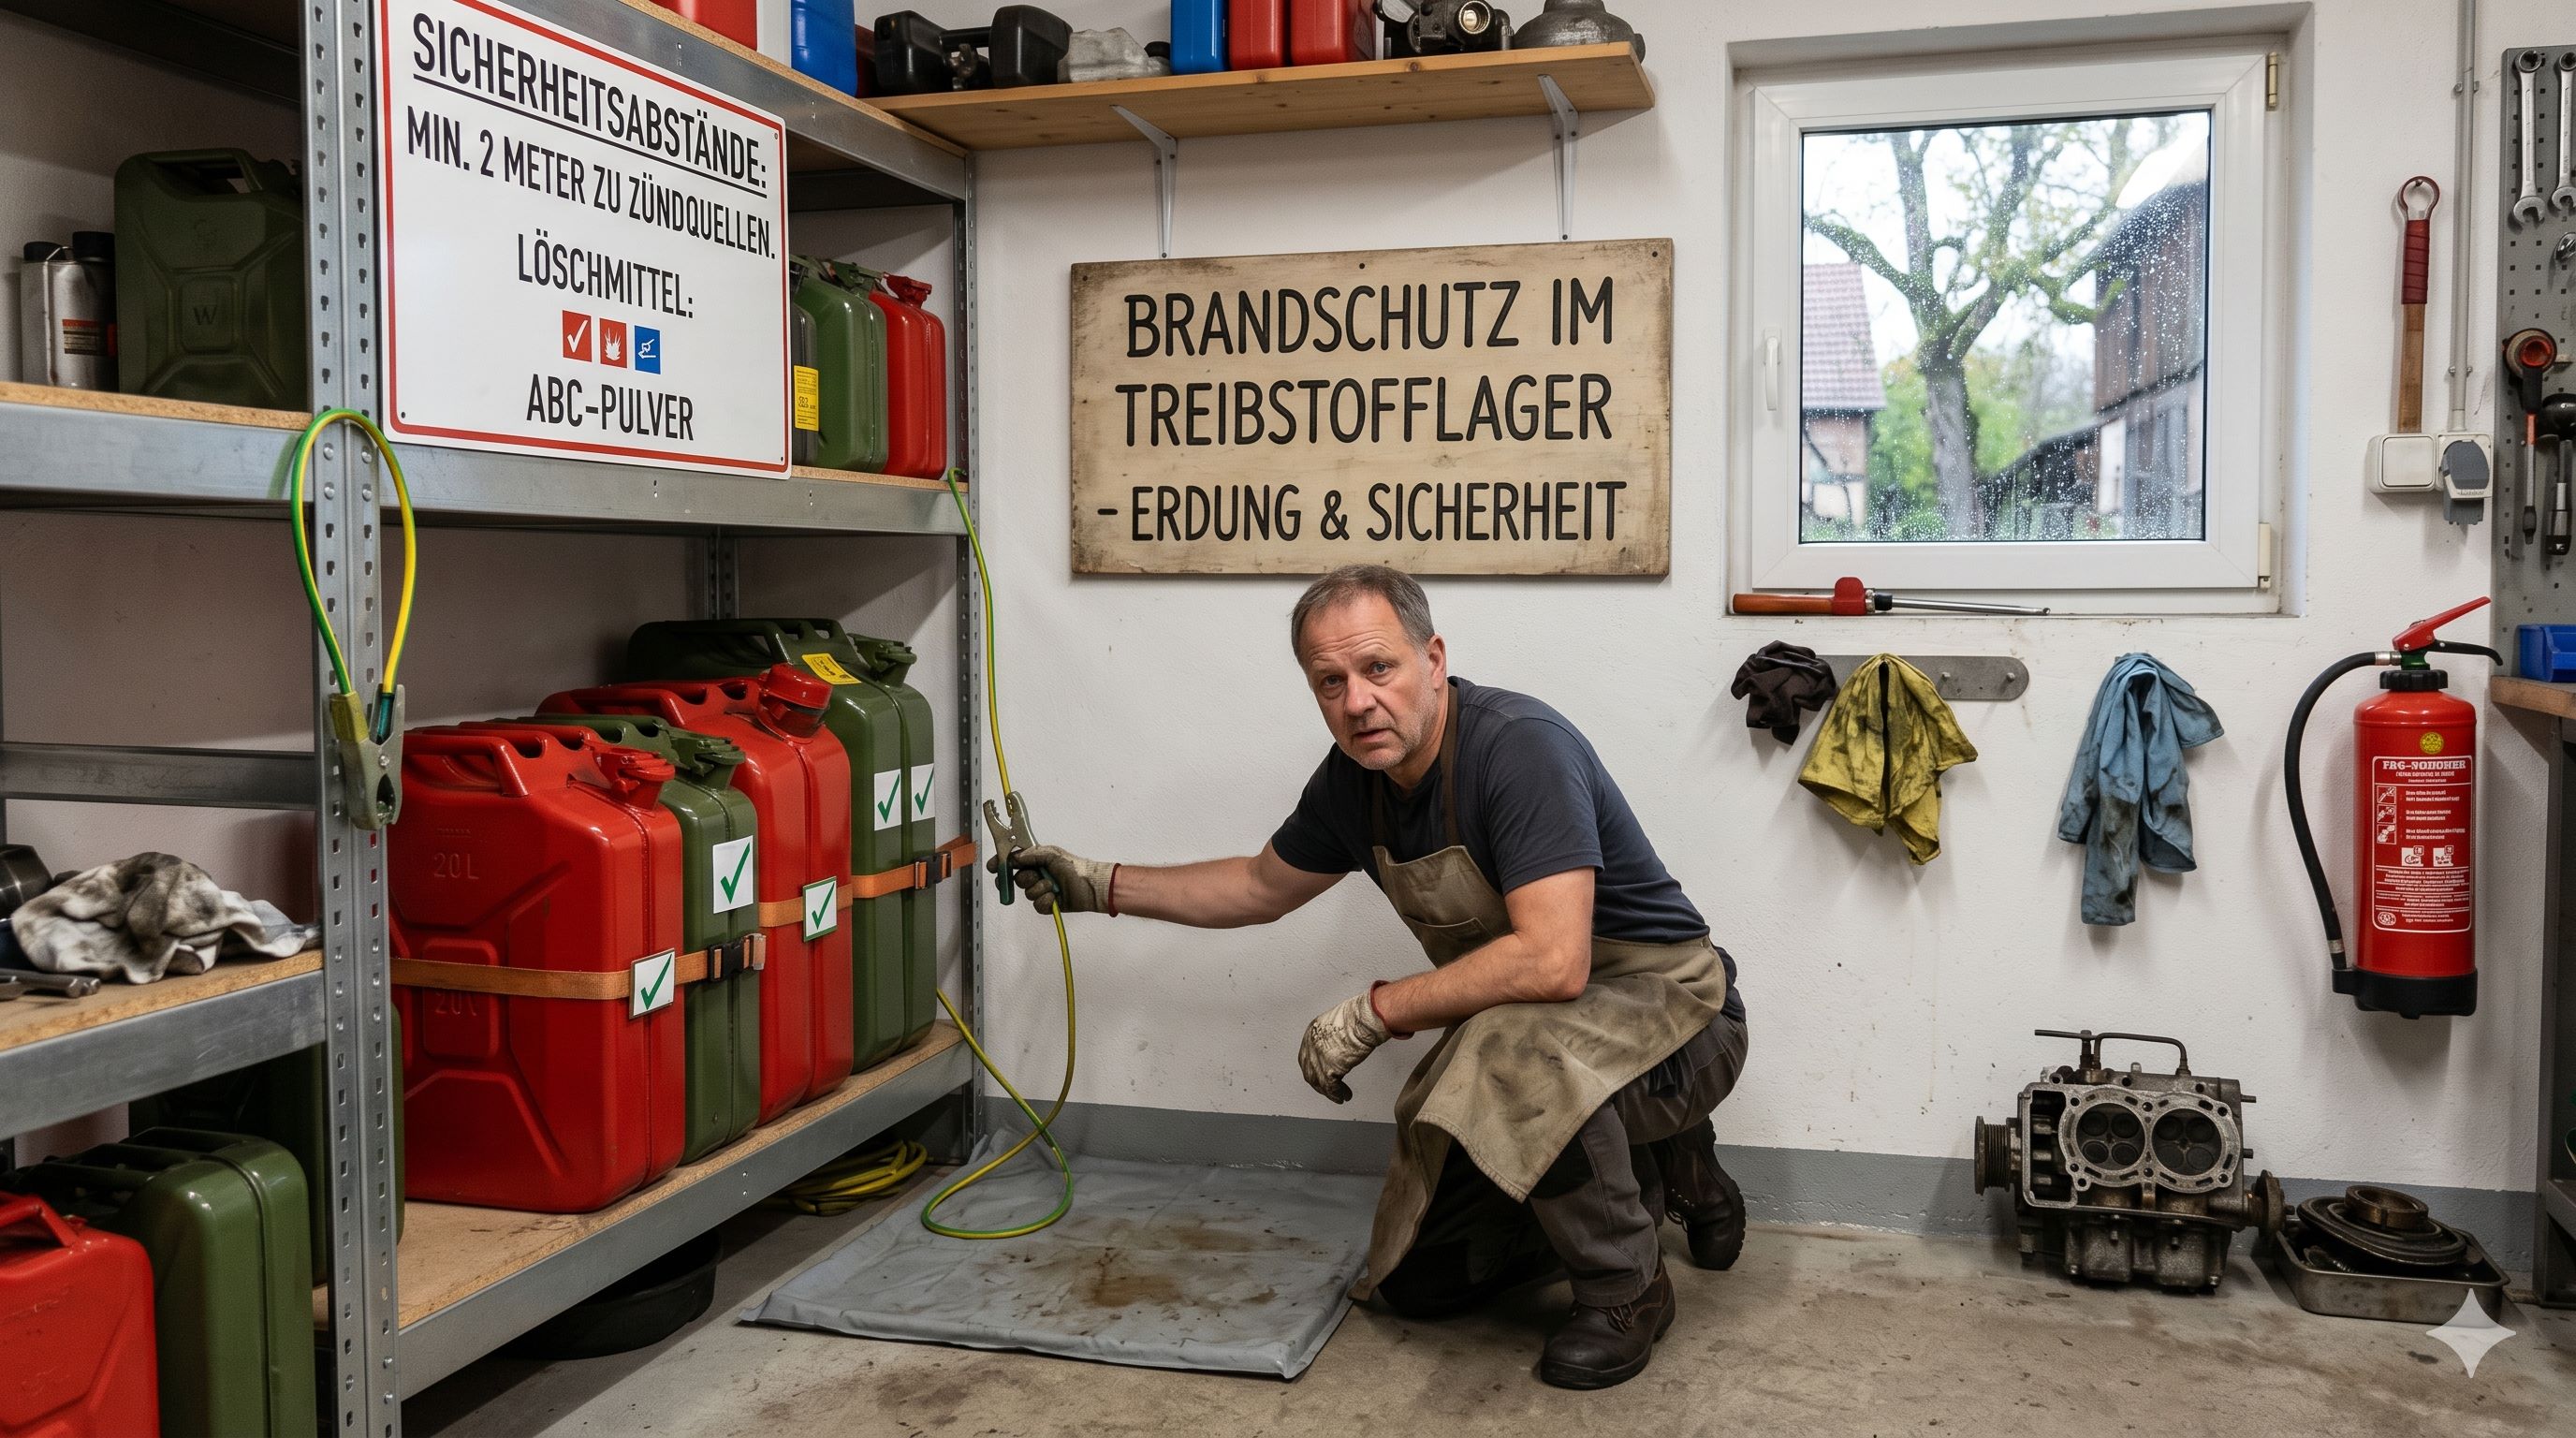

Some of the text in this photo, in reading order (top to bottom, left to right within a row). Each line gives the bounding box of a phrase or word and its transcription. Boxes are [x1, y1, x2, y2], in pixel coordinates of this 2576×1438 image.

[413, 12, 768, 189] SICHERHEITSABSTÄNDE:
[407, 105, 777, 259] MIN. 2 METER ZU ZÜNDQUELLEN.
[518, 228, 695, 318] LÖSCHMITTEL:
[1123, 276, 1614, 359] BRANDSCHUTZ IM
[526, 374, 695, 441] ABC-PULVER
[1114, 373, 1613, 448] TREIBSTOFFLAGER
[1320, 490, 1351, 541] &
[1366, 480, 1628, 542] SICHERHEIT
